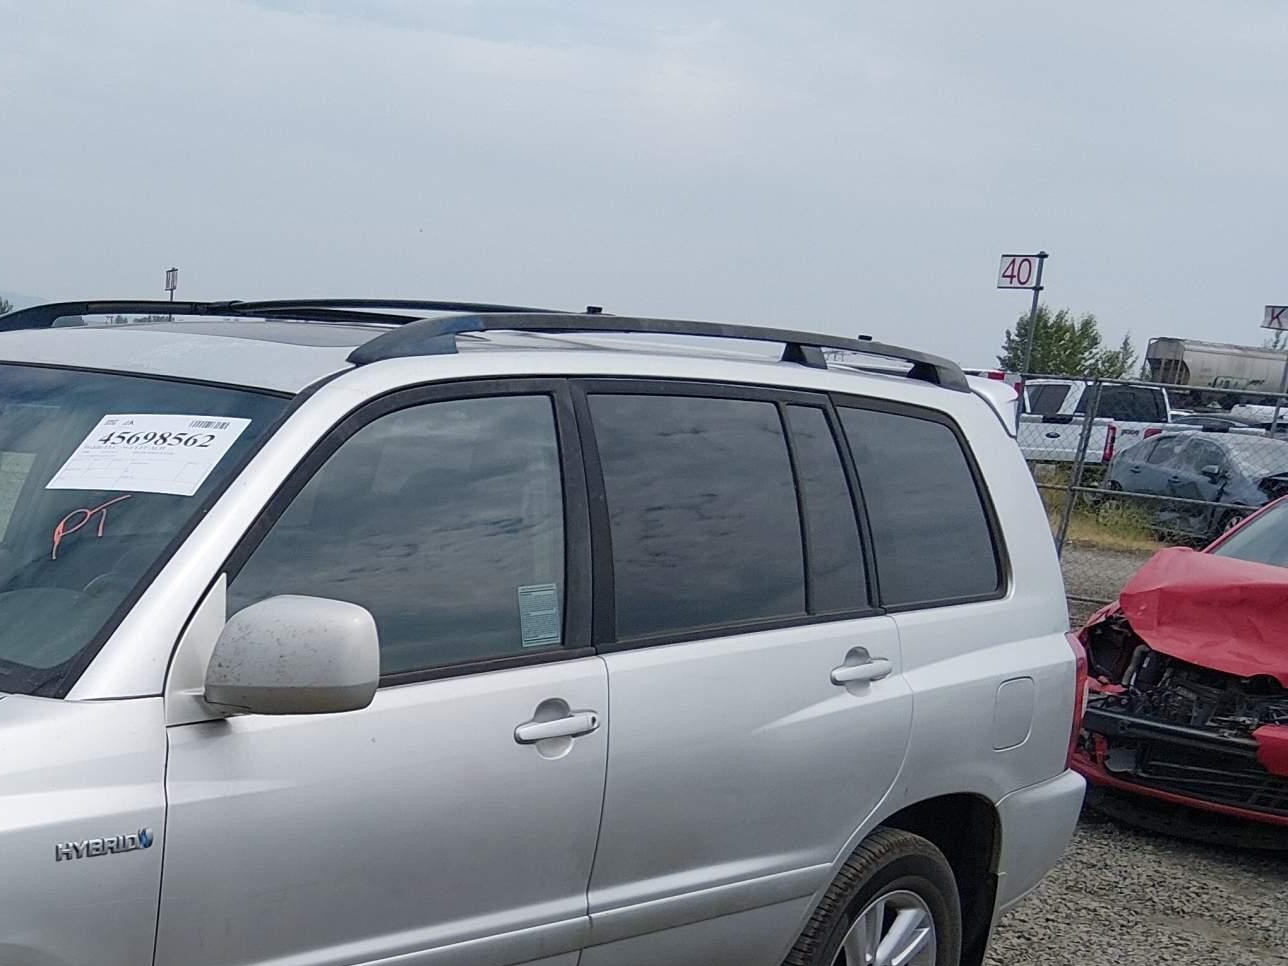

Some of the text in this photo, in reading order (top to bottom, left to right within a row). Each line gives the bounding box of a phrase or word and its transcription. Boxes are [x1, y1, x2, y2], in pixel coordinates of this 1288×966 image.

[1002, 257, 1032, 286] 40
[1268, 308, 1286, 328] K
[97, 430, 216, 449] 45698562
[55, 833, 139, 863] HYBRID
